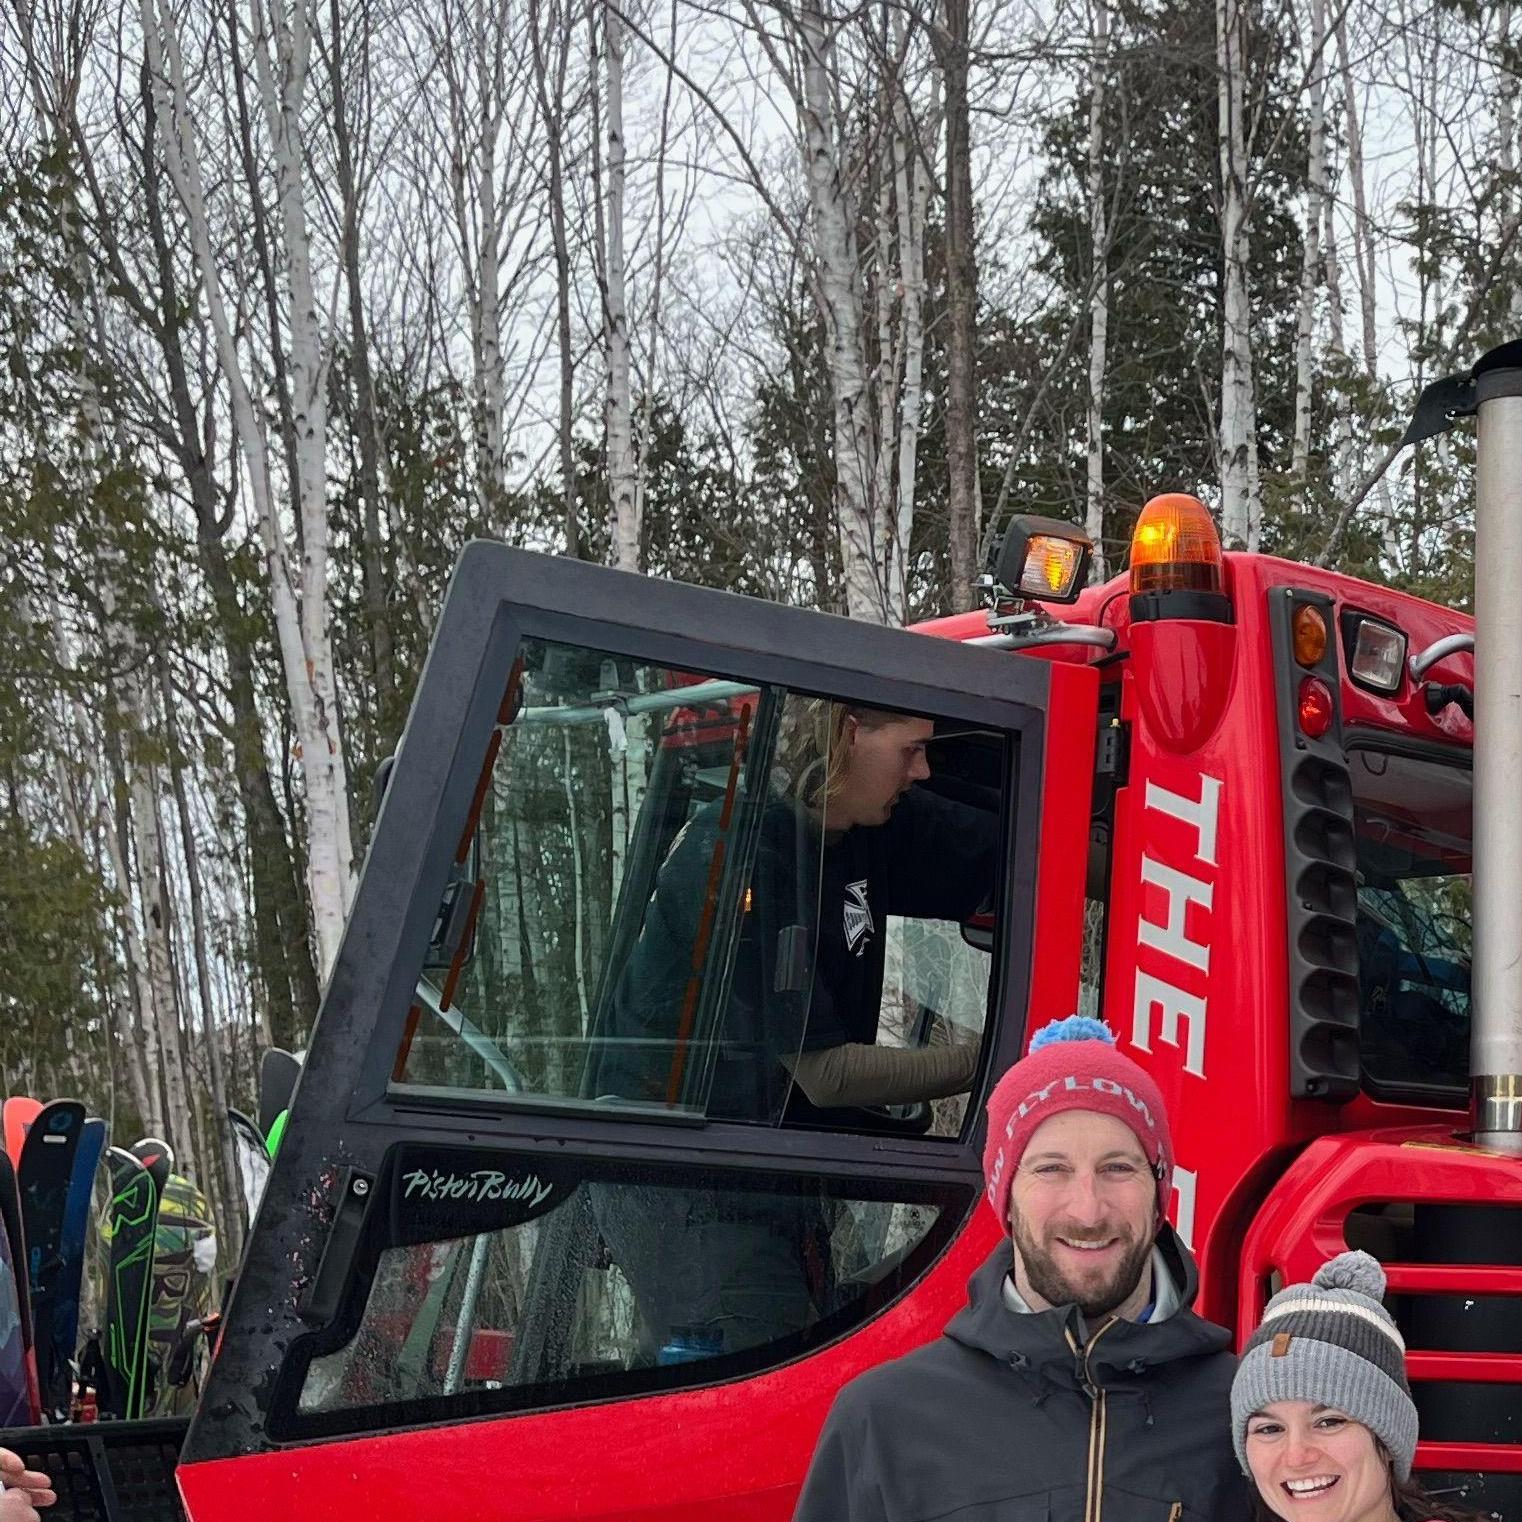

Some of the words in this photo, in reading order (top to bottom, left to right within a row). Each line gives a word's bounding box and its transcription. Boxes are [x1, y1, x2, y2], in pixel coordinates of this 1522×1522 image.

[1130, 773, 1224, 1080] THE
[1006, 1076, 1155, 1139] FLYLOW
[402, 1168, 553, 1208] PistenBully
